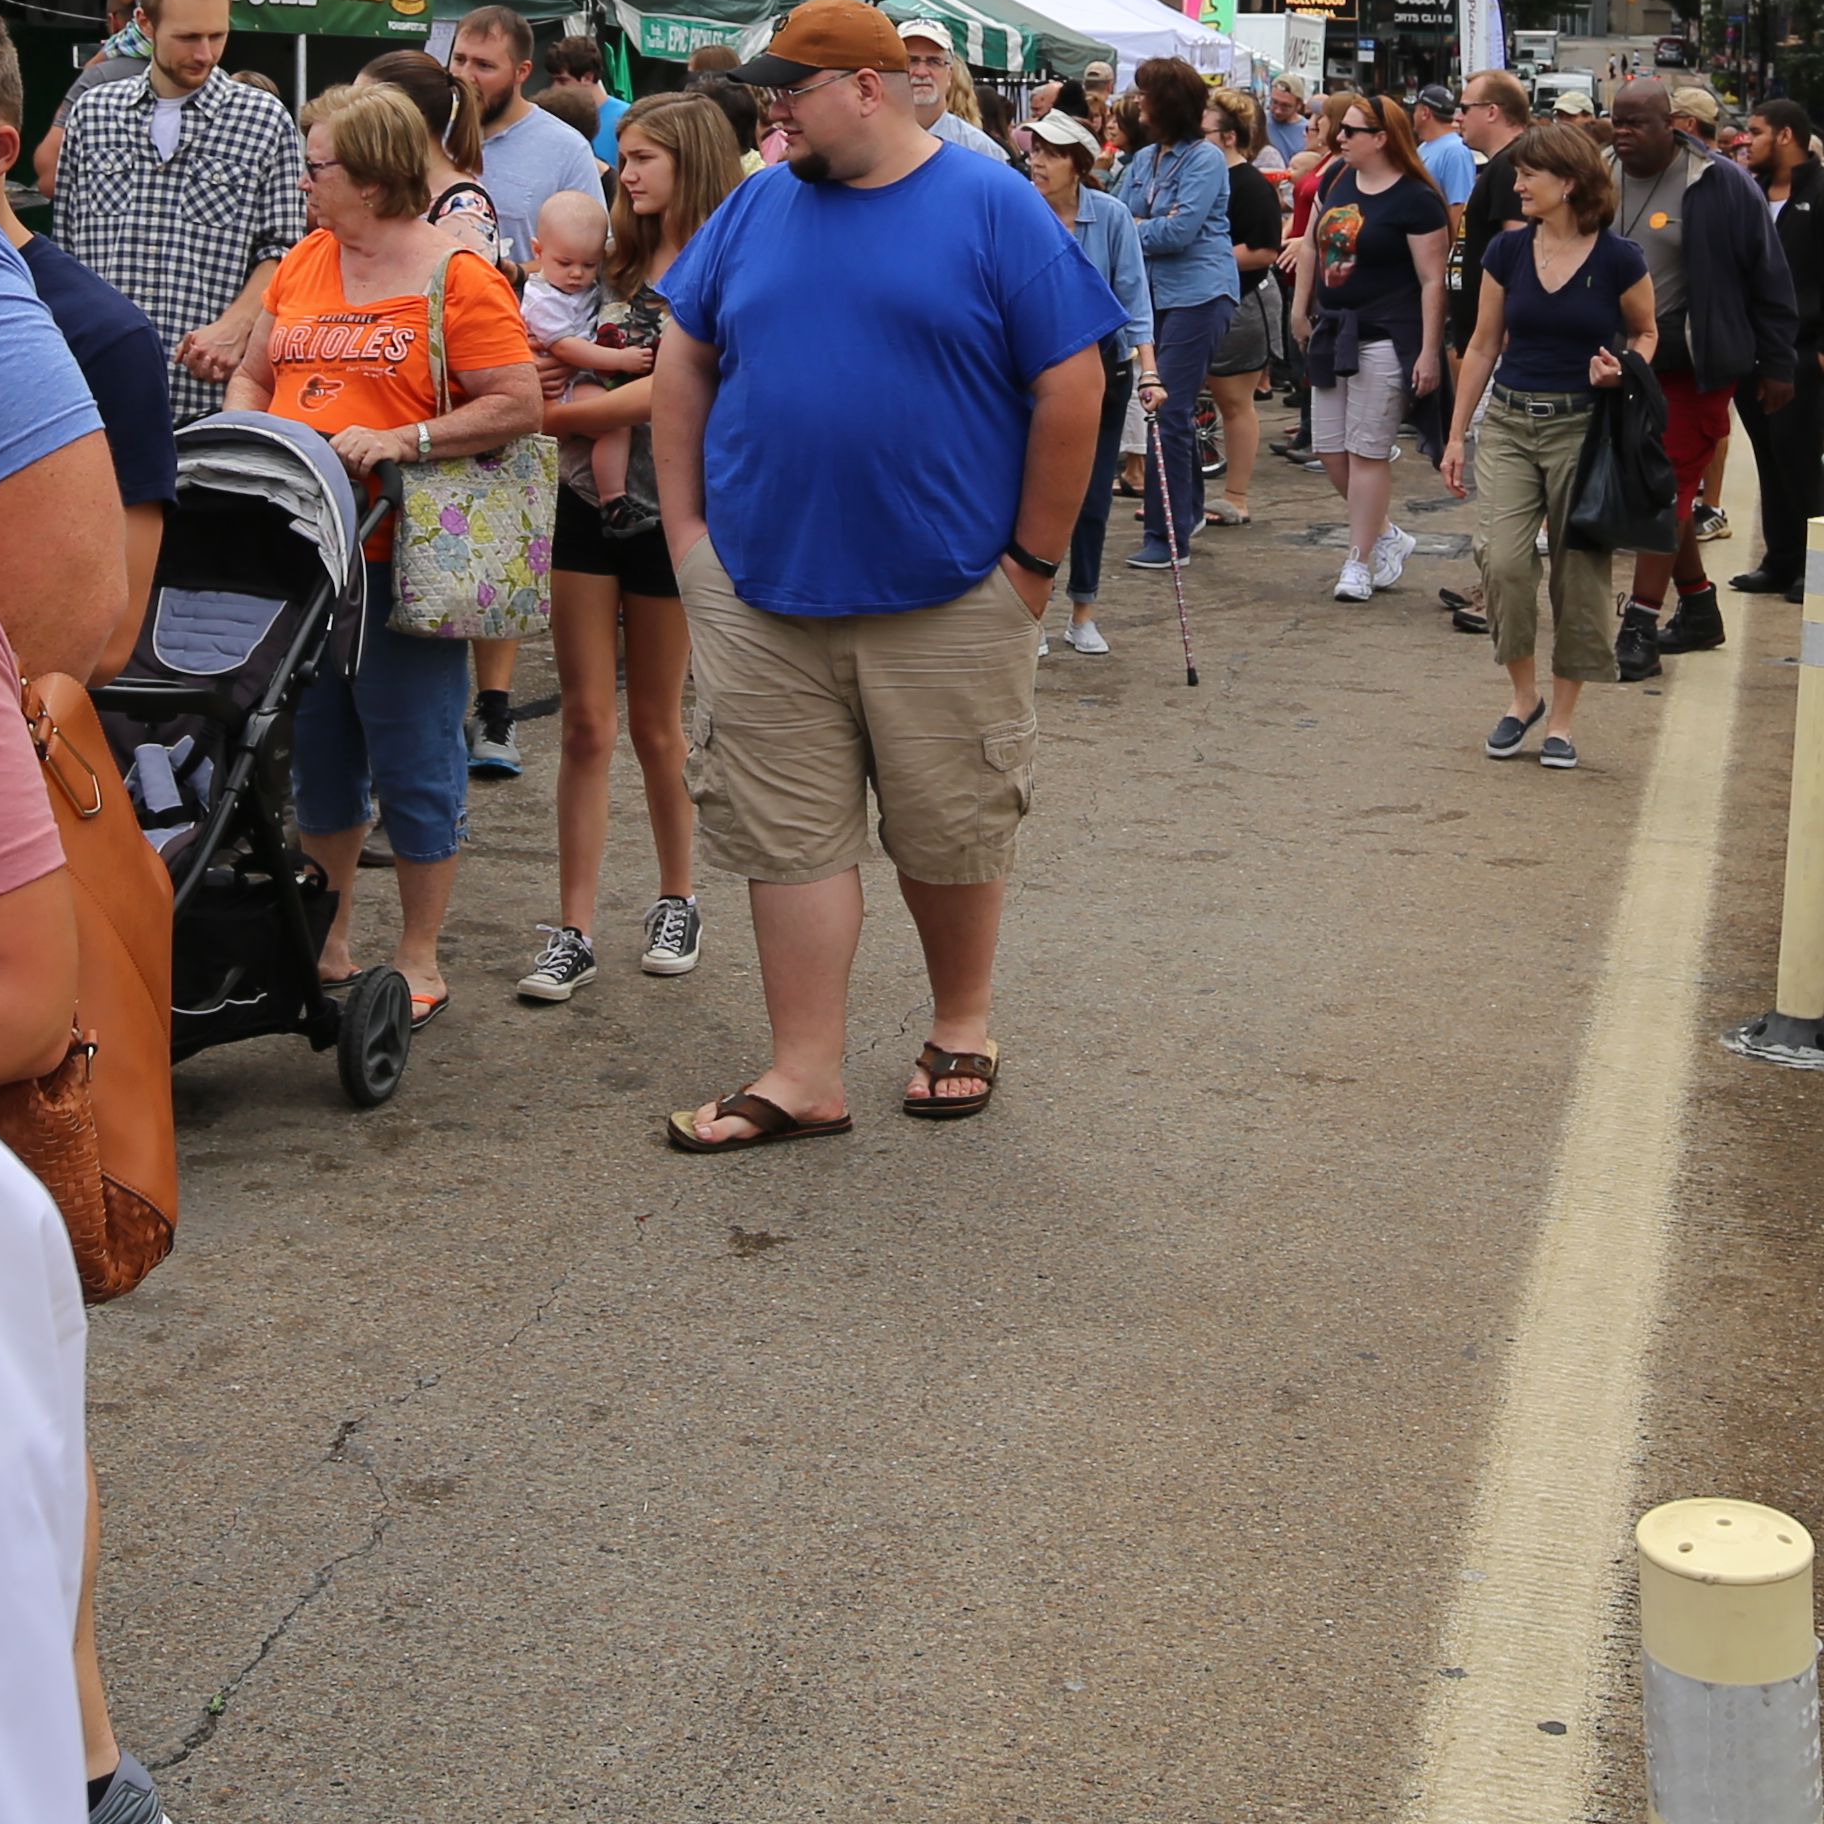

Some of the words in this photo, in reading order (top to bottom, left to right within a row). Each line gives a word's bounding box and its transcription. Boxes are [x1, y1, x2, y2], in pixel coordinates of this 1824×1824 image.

[668, 25, 689, 53] EPIC
[318, 314, 373, 324] BALTIMORE
[271, 325, 416, 364] ORIOLES
